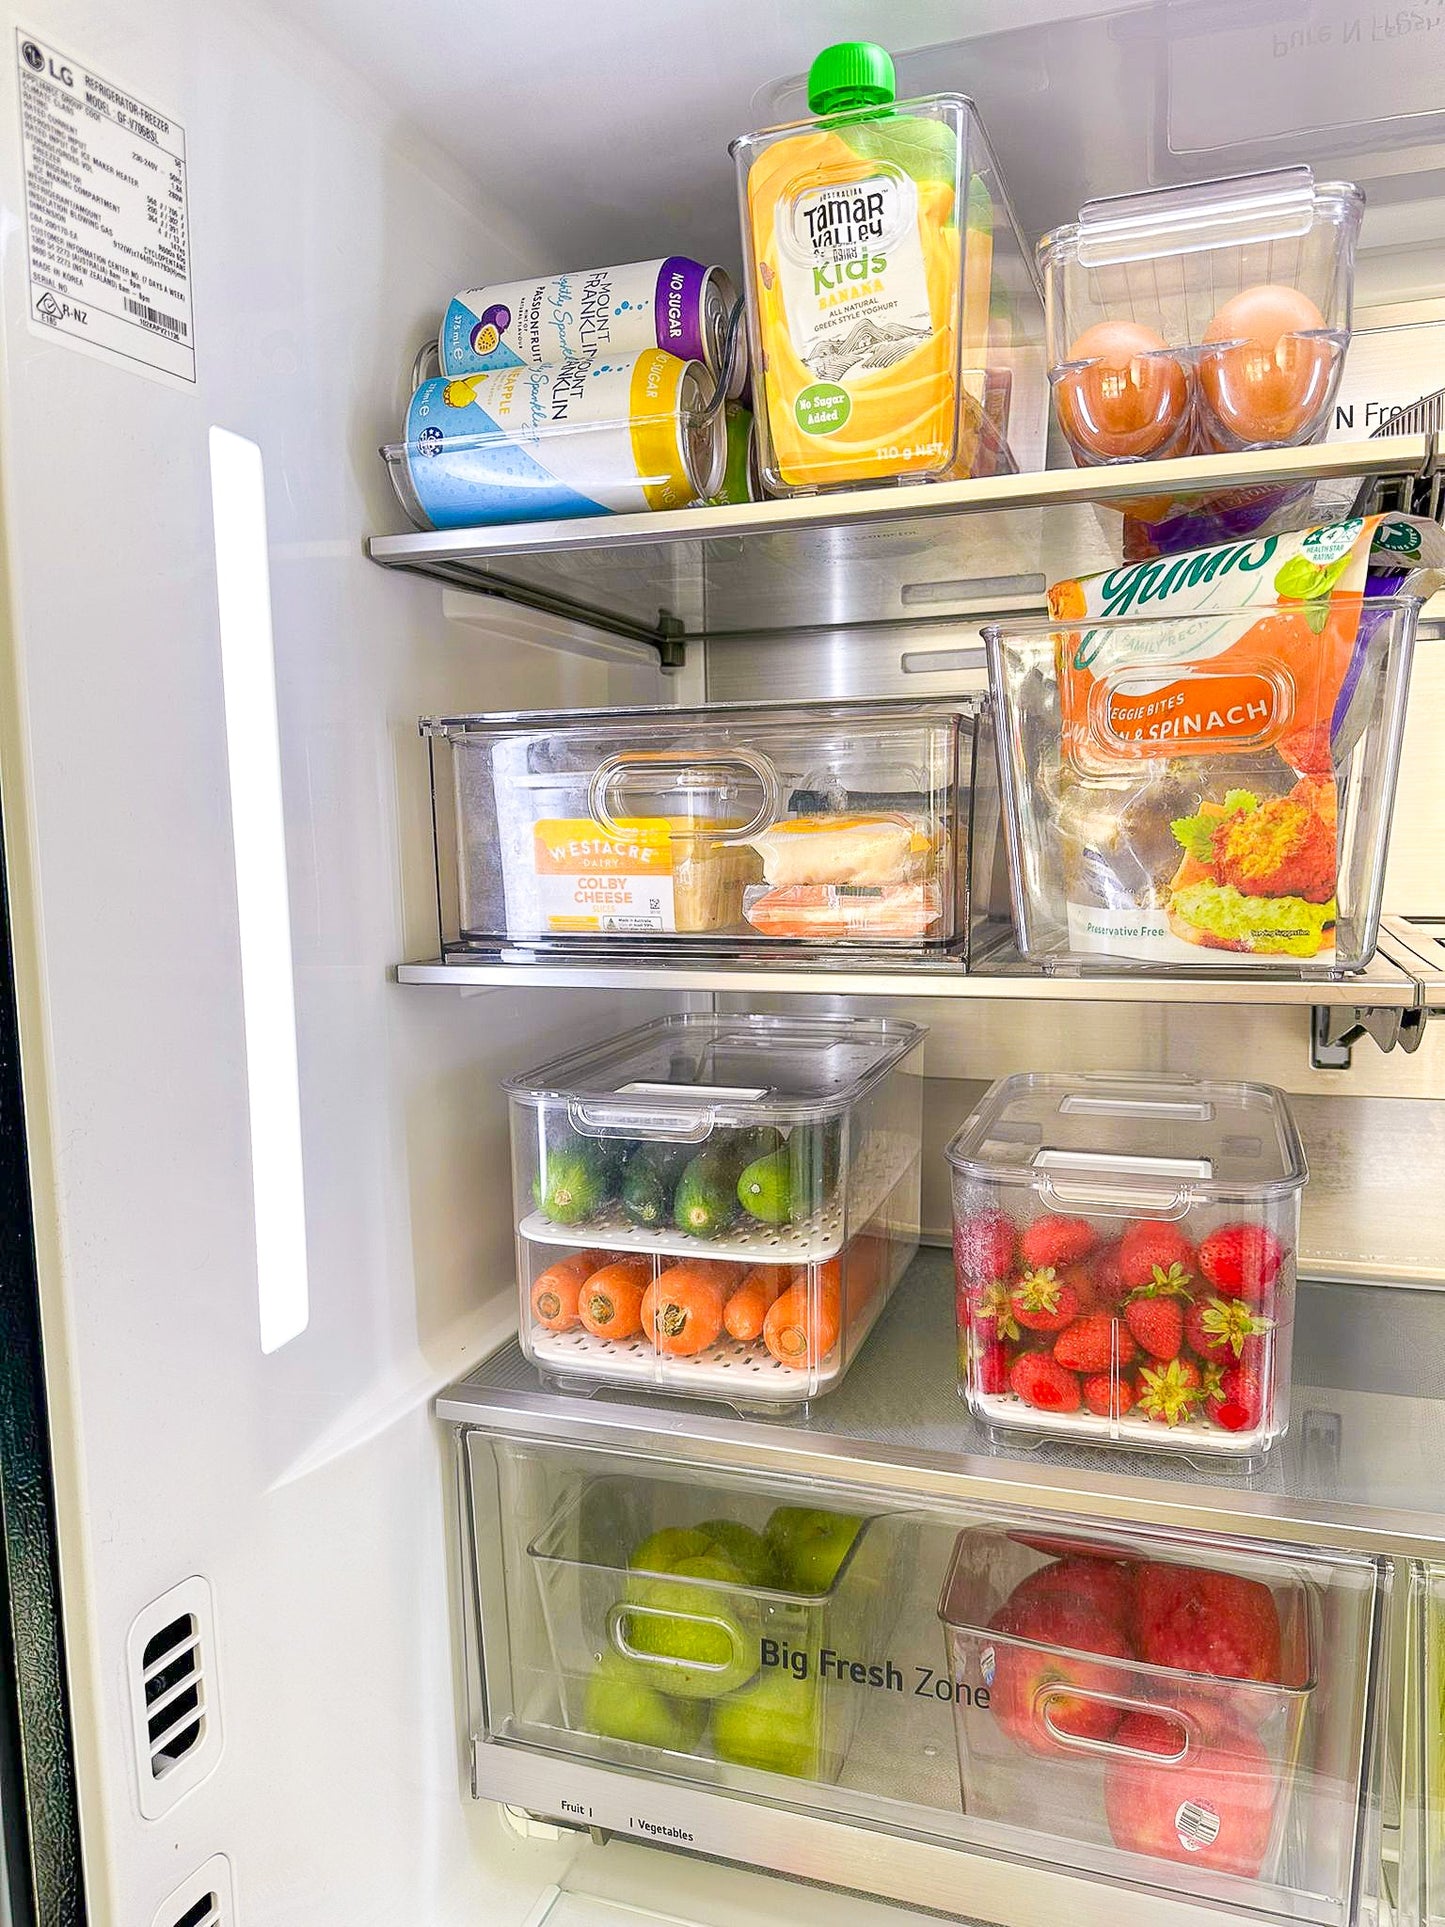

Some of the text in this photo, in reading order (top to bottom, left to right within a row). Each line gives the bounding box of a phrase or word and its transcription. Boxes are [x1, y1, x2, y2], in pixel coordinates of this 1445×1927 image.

[49, 57, 73, 88] LG
[85, 91, 110, 116] MODEL
[85, 74, 169, 135] REFRIGERATOR-FREEZER
[813, 246, 887, 296] Kids
[668, 272, 684, 338] NO SUGAR
[818, 278, 885, 311] BANANA
[596, 282, 612, 343] MOUNT
[814, 300, 899, 332] GREEK STYLE YOGHURT
[829, 297, 879, 318] ALL NATURAL
[530, 286, 546, 362] PASSIONFRUIT
[646, 363, 664, 399] SUGAR
[800, 394, 845, 411] No Sugar
[807, 410, 839, 425] Added
[1336, 404, 1354, 430] N
[876, 446, 899, 460] 110
[1306, 544, 1344, 553] HEALTH STAR
[1312, 553, 1335, 561] RATING
[1146, 692, 1185, 716] BITES
[1149, 699, 1268, 741] SPINACH
[549, 840, 654, 863] WESTACRE
[583, 859, 619, 868] DAIRY
[577, 878, 628, 890] COLBY
[574, 891, 633, 904] CHEESE
[1087, 922, 1164, 937] Preservative Free
[760, 1637, 991, 1709] Big Fresh Zone
[561, 1800, 694, 1842] Fruit Vegetables
